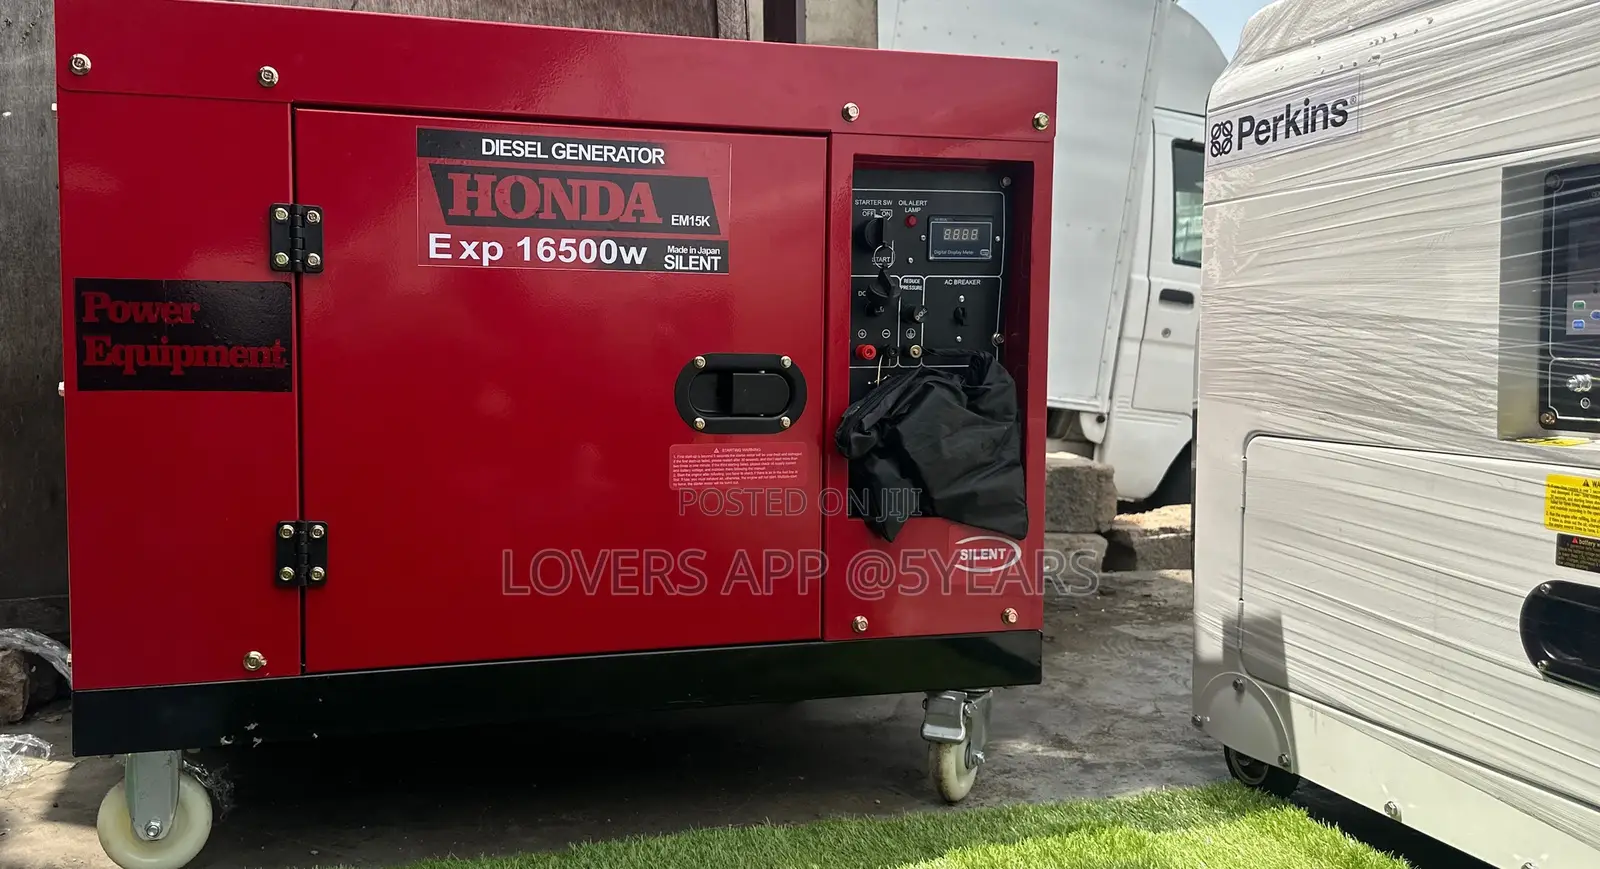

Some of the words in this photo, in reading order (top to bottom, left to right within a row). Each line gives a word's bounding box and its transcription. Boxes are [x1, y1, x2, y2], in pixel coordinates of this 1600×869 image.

[1237, 97, 1349, 151] Perkins
[481, 138, 548, 159] DIESEL
[551, 142, 665, 165] GENERATOR
[448, 172, 663, 224] HONDA
[671, 215, 711, 227] EM15K
[517, 236, 648, 265] 16500w
[664, 254, 721, 271] SILENT
[667, 245, 688, 254] Made
[689, 246, 696, 255] in
[697, 246, 720, 257] Japan
[81, 291, 200, 324] Power
[82, 335, 286, 376] Equipment
[960, 548, 1006, 561] SILENT
